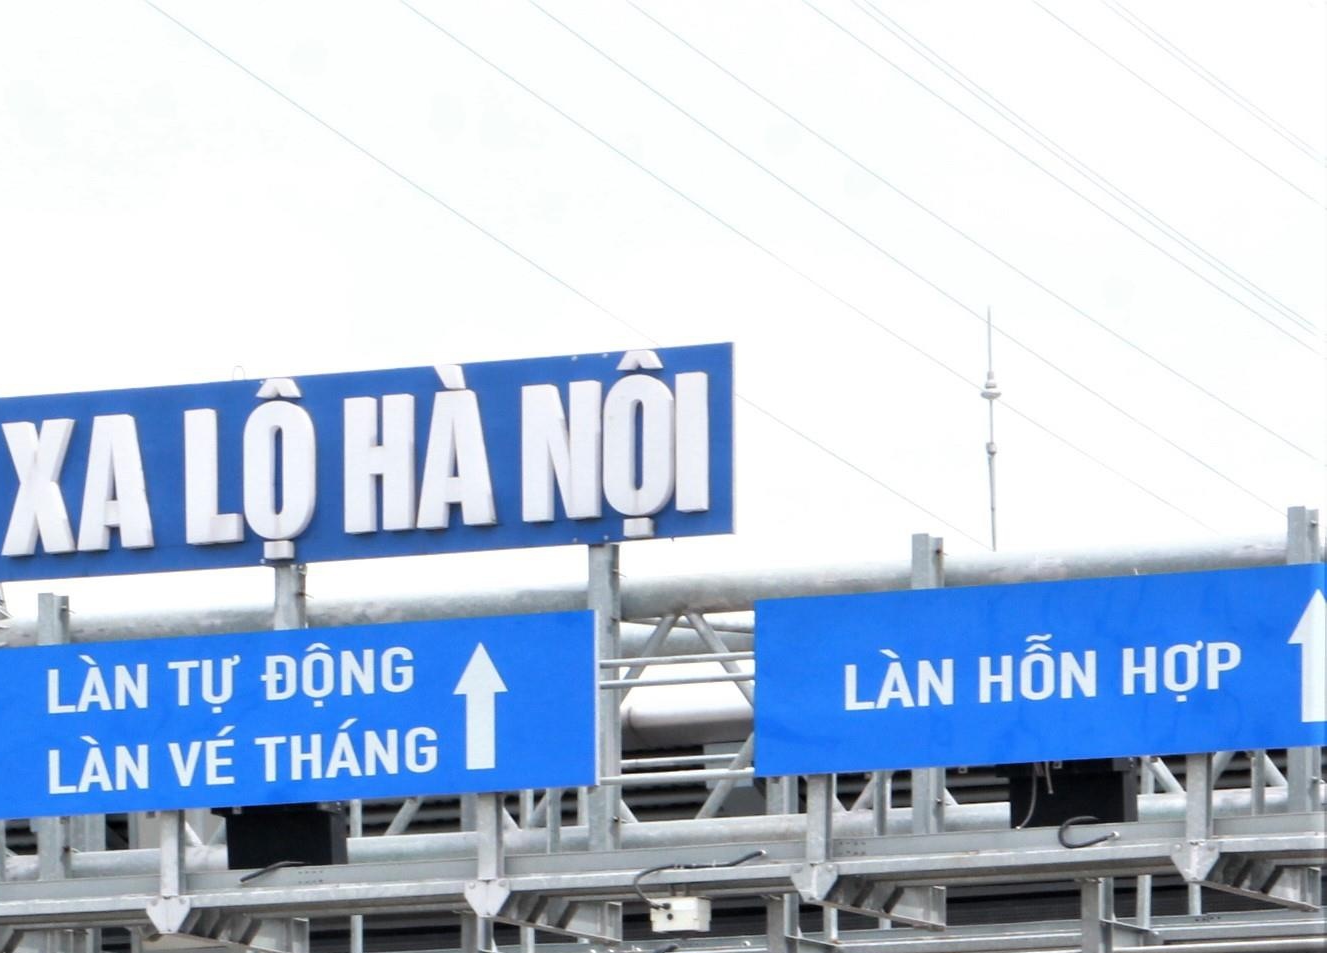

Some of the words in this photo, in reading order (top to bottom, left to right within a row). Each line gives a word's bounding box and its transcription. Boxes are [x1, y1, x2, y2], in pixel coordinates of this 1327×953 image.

[1, 414, 154, 557] XA
[184, 378, 317, 560] LỘ
[343, 364, 497, 535] HÀ
[521, 349, 709, 539] NỘI
[47, 655, 148, 714] LÀN
[168, 654, 240, 714] TỰ
[261, 642, 414, 708] ĐỘNG
[844, 649, 954, 711] LÀN
[979, 633, 1097, 704] HỖN
[1122, 639, 1241, 703] HỢP
[48, 735, 149, 795] LÀN
[169, 725, 236, 788] VÉ
[255, 718, 438, 783] THÁNG
